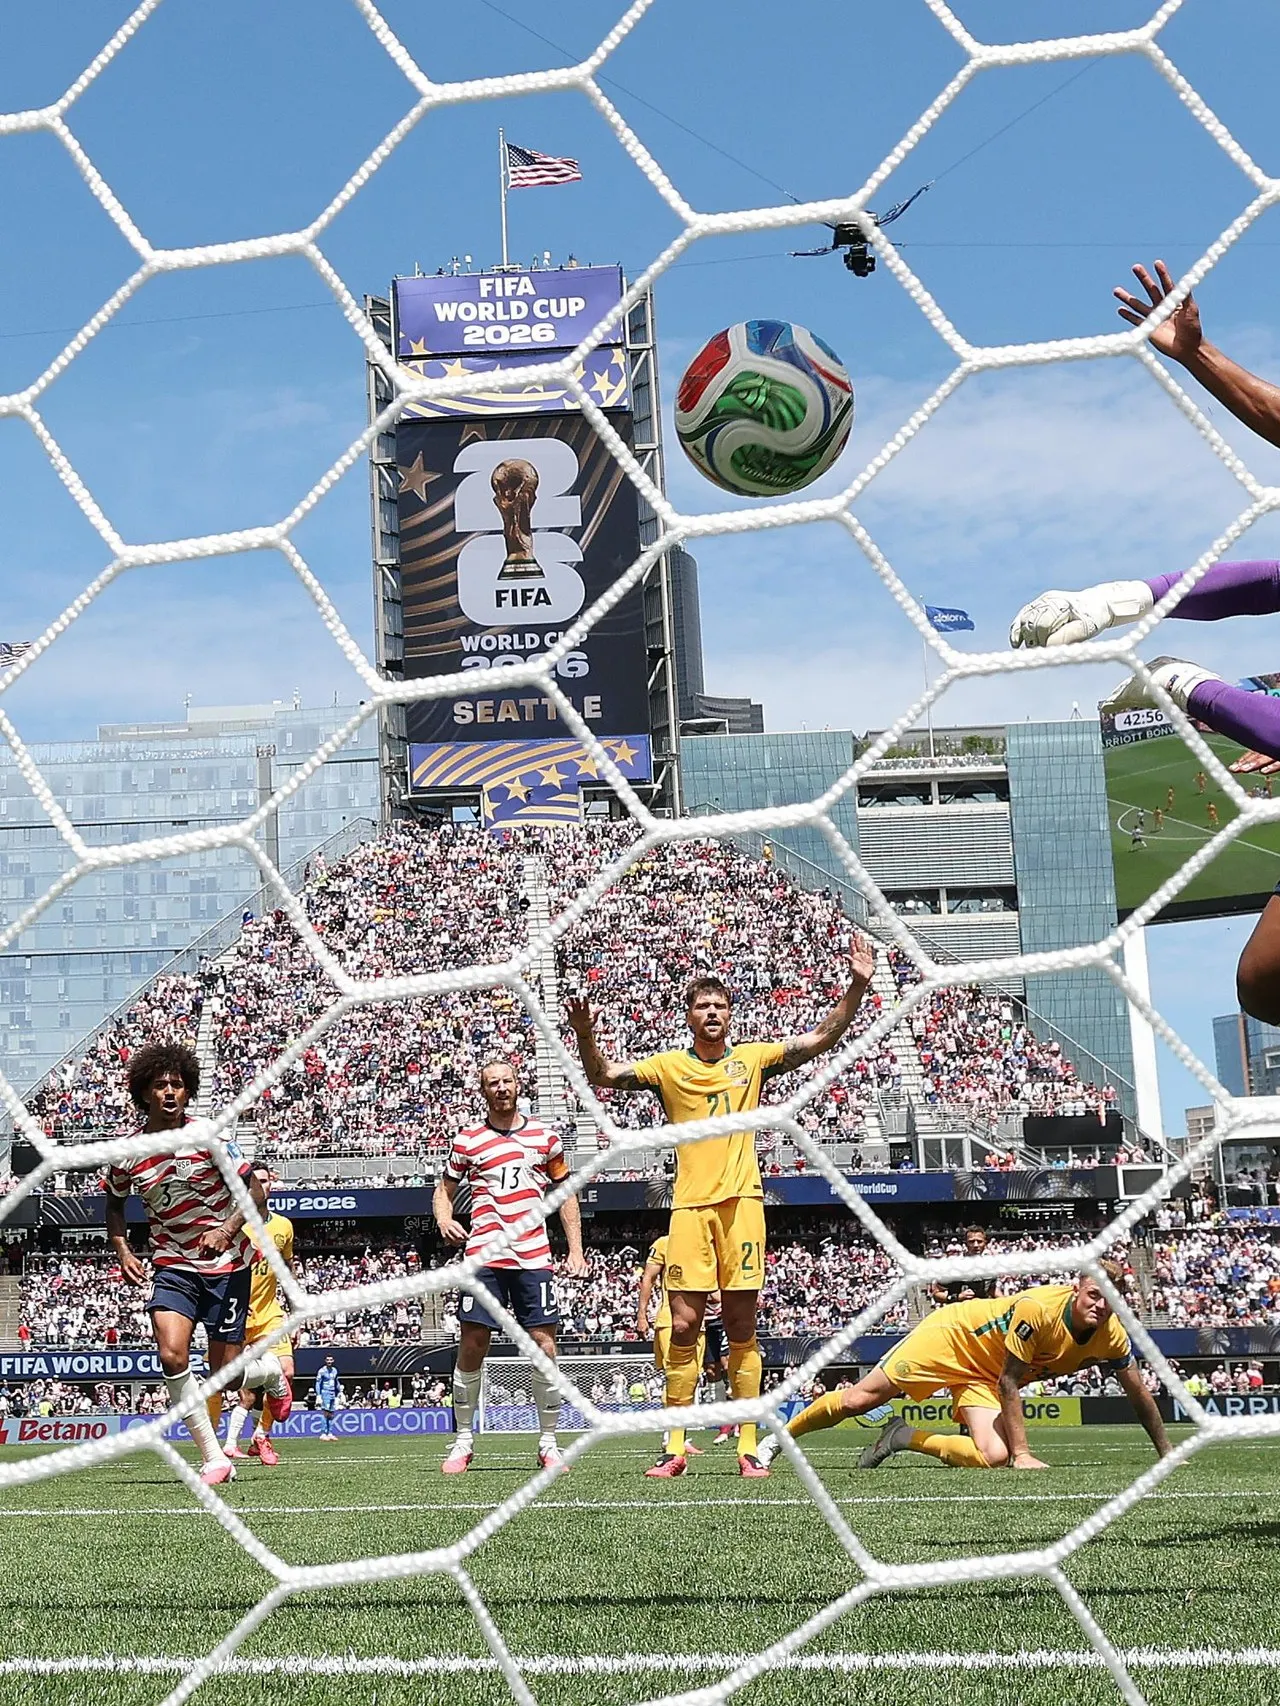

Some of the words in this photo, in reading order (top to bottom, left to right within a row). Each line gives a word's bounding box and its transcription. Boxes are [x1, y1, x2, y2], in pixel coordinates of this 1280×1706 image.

[479, 277, 536, 298] FIFA
[434, 301, 529, 322] WORLD
[532, 297, 586, 319] CUP
[463, 323, 556, 345] 2026
[495, 588, 553, 608] FIFA
[460, 632, 541, 652] WORLD
[453, 695, 603, 725] SEATTE
[1123, 710, 1164, 726] 42:56
[501, 1166, 521, 1190] 13
[160, 1183, 171, 1207] 3
[266, 1198, 297, 1211] CUP
[300, 1196, 356, 1210] 2026
[741, 1241, 762, 1270] 21
[540, 1281, 557, 1307] 13
[224, 1297, 238, 1324] 3
[2, 1356, 51, 1374] FIFA
[52, 1355, 137, 1374] WORLD
[18, 1419, 108, 1441] Betano
